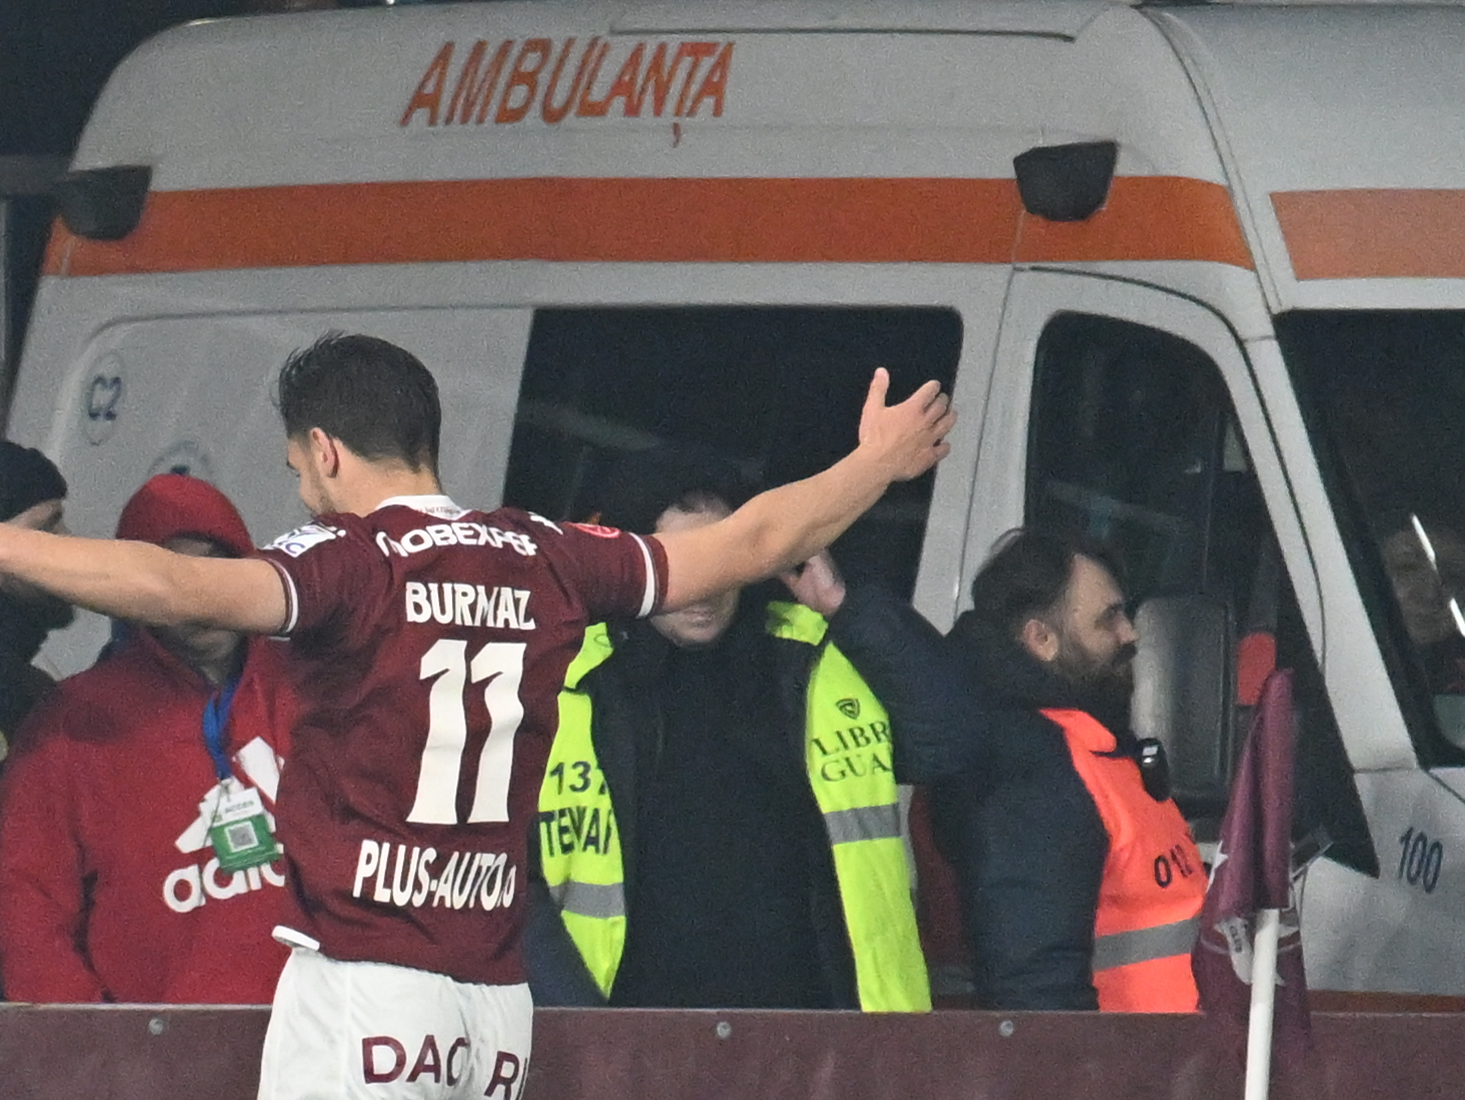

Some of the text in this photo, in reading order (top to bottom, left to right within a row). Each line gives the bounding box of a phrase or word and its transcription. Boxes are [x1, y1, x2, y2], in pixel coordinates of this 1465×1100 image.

[405, 582, 537, 630] BURMAZ
[406, 640, 526, 825] 11
[810, 721, 892, 756] LIBR
[820, 752, 892, 782] GUA
[1399, 826, 1444, 894] 100
